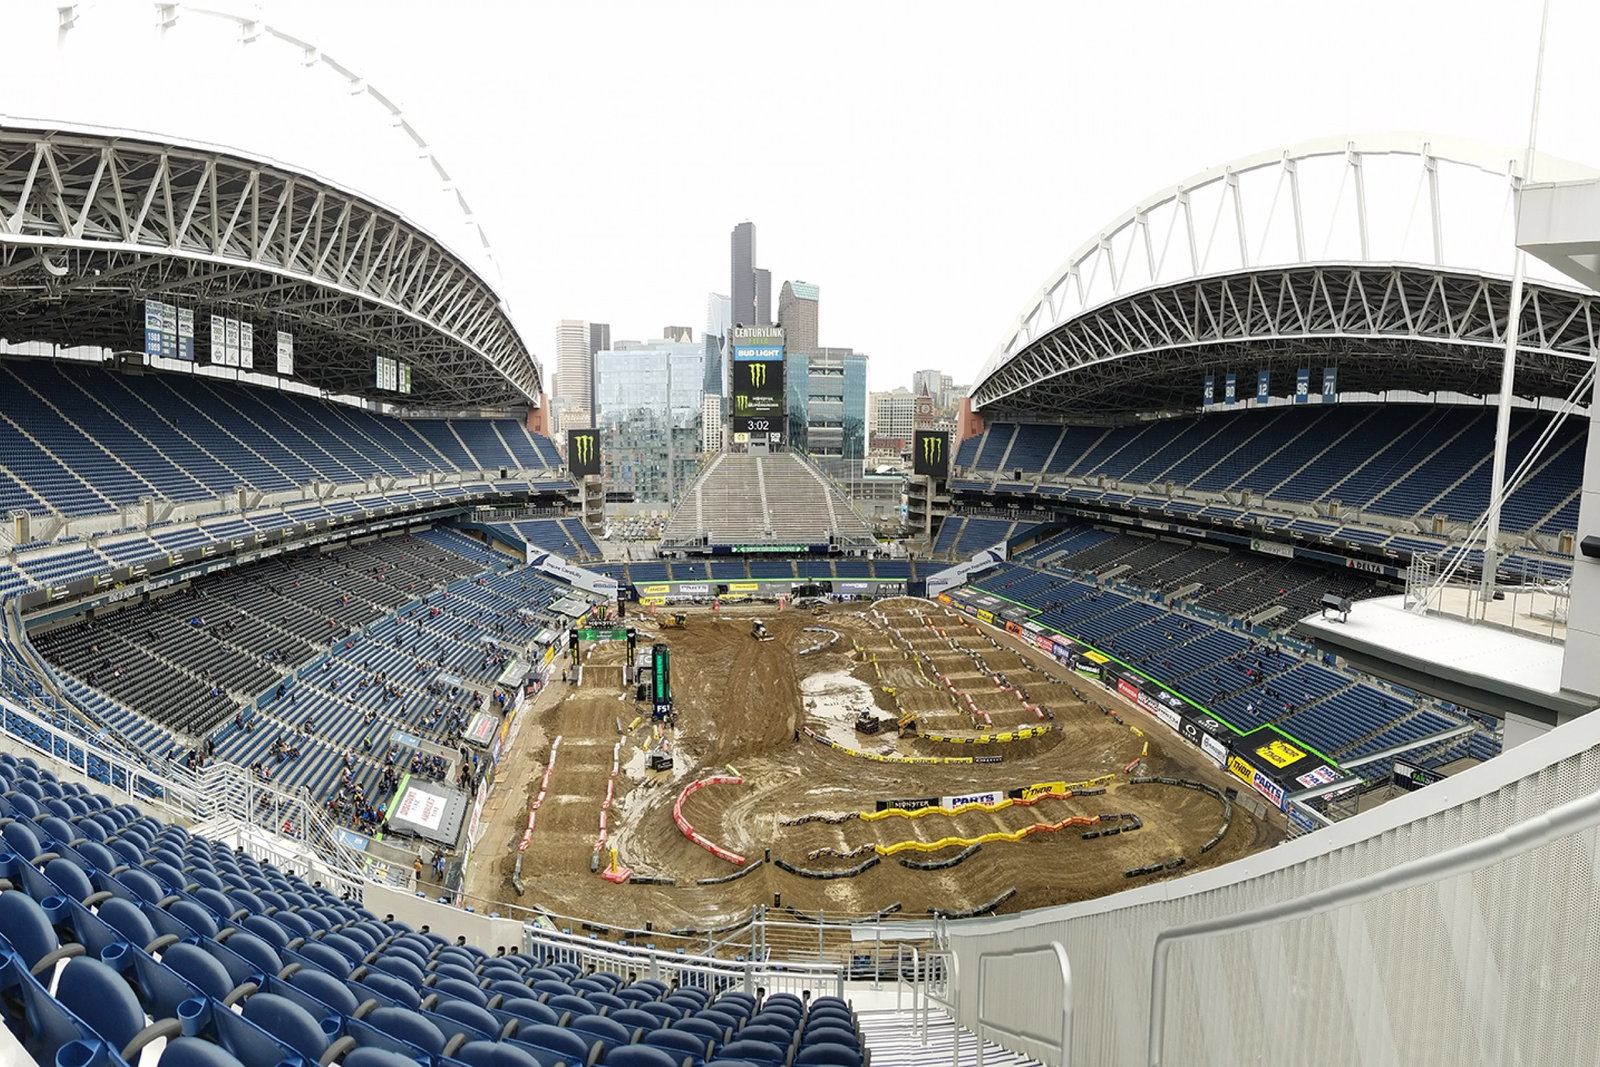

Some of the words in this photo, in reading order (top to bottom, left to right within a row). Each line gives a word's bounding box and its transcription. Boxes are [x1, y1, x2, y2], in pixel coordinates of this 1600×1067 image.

[738, 349, 755, 357] BUD
[756, 349, 780, 357] LIGHT
[1204, 386, 1214, 398] 45
[1225, 386, 1235, 397] 80
[1258, 384, 1268, 396] 12
[1296, 382, 1308, 395] 96
[1324, 382, 1335, 395] 71
[747, 420, 769, 431] 3:02
[1357, 561, 1382, 573] DELTA
[1233, 760, 1252, 779] THOR
[1030, 786, 1053, 796] THOR
[1254, 772, 1282, 798] PARTS
[894, 800, 929, 808] MONSTER
[952, 794, 994, 806] PARTS
